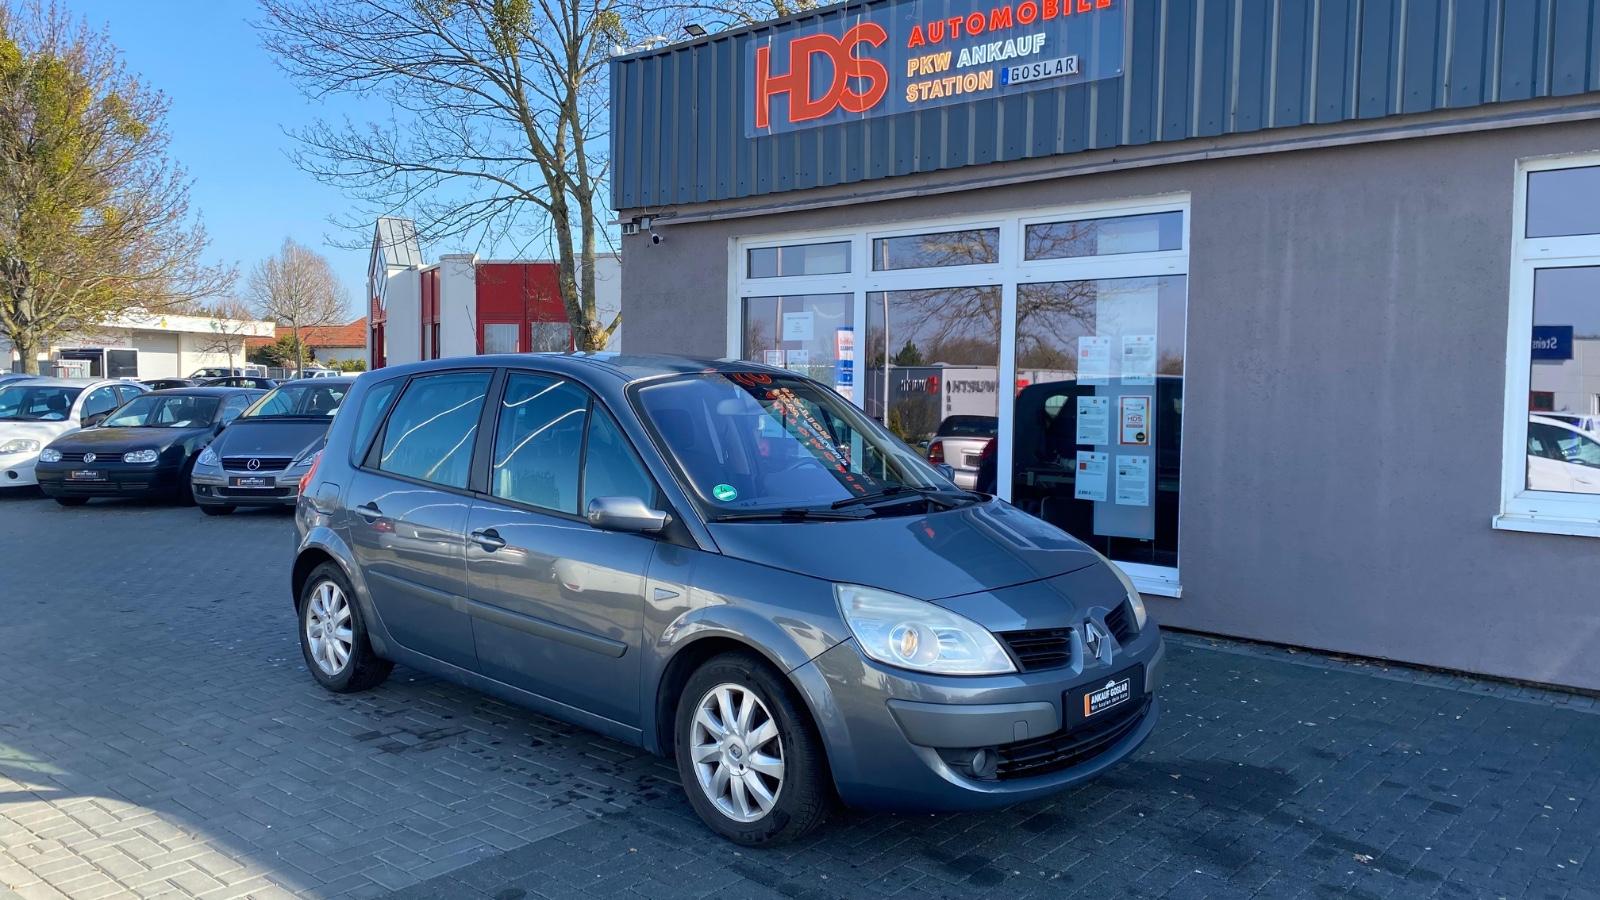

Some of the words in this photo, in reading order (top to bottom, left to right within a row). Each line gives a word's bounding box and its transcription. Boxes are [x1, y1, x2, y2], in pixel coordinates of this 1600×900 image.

[907, 51, 952, 77] PKW
[956, 32, 1046, 68] ANKAUF
[1011, 57, 1075, 82] GOSLAR
[755, 22, 888, 128] HDS
[906, 69, 993, 102] STATION
[1091, 690, 1110, 704] ANKAUF
[1110, 683, 1127, 696] GOSLAR
